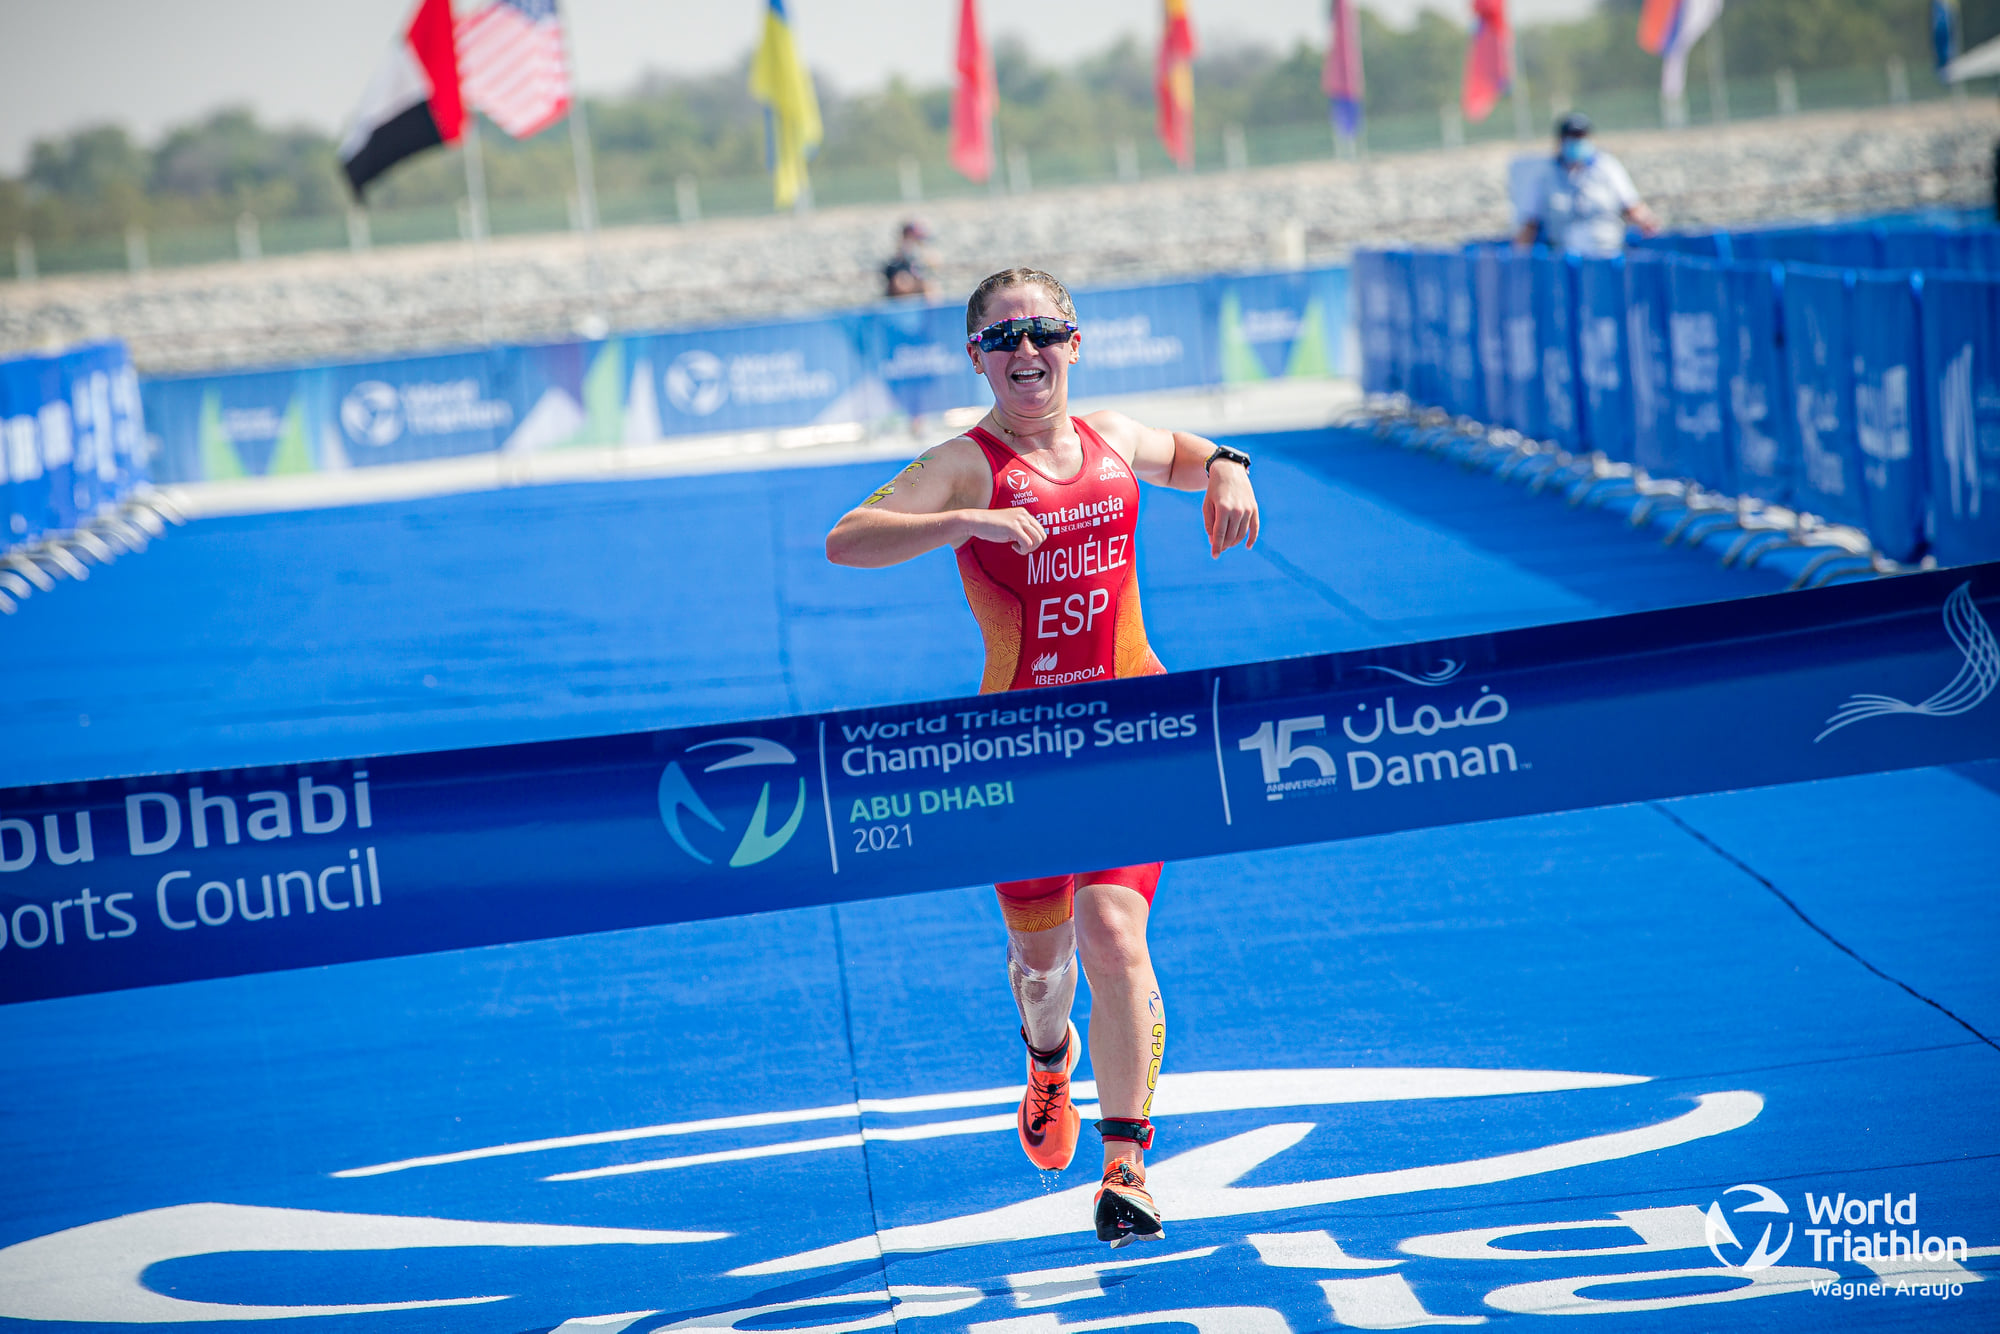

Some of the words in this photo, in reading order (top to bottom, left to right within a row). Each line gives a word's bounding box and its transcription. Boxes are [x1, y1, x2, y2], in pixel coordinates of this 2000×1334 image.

[1010, 496, 1039, 507] Triathlon
[1013, 490, 1033, 500] World
[1031, 495, 1124, 527] antalucía
[1060, 519, 1092, 533] SEGUROS
[1027, 534, 1128, 585] MIGUÉLEZ
[1037, 588, 1109, 639] ESP
[1035, 665, 1105, 685] IBERDROLA
[841, 716, 947, 743] World
[955, 700, 1108, 729] Triathlon
[1343, 685, 1508, 743] ضمان
[842, 724, 1085, 777] Championship
[1094, 712, 1197, 747] Series
[1238, 715, 1337, 784] 15
[1346, 741, 1517, 791] Daman
[850, 793, 912, 823] ABU
[919, 780, 1014, 815] DHABI
[1266, 777, 1337, 793] ANNIVERSARY
[125, 770, 372, 856] Dhabi
[853, 823, 913, 853] 2021
[156, 846, 382, 931] Council
